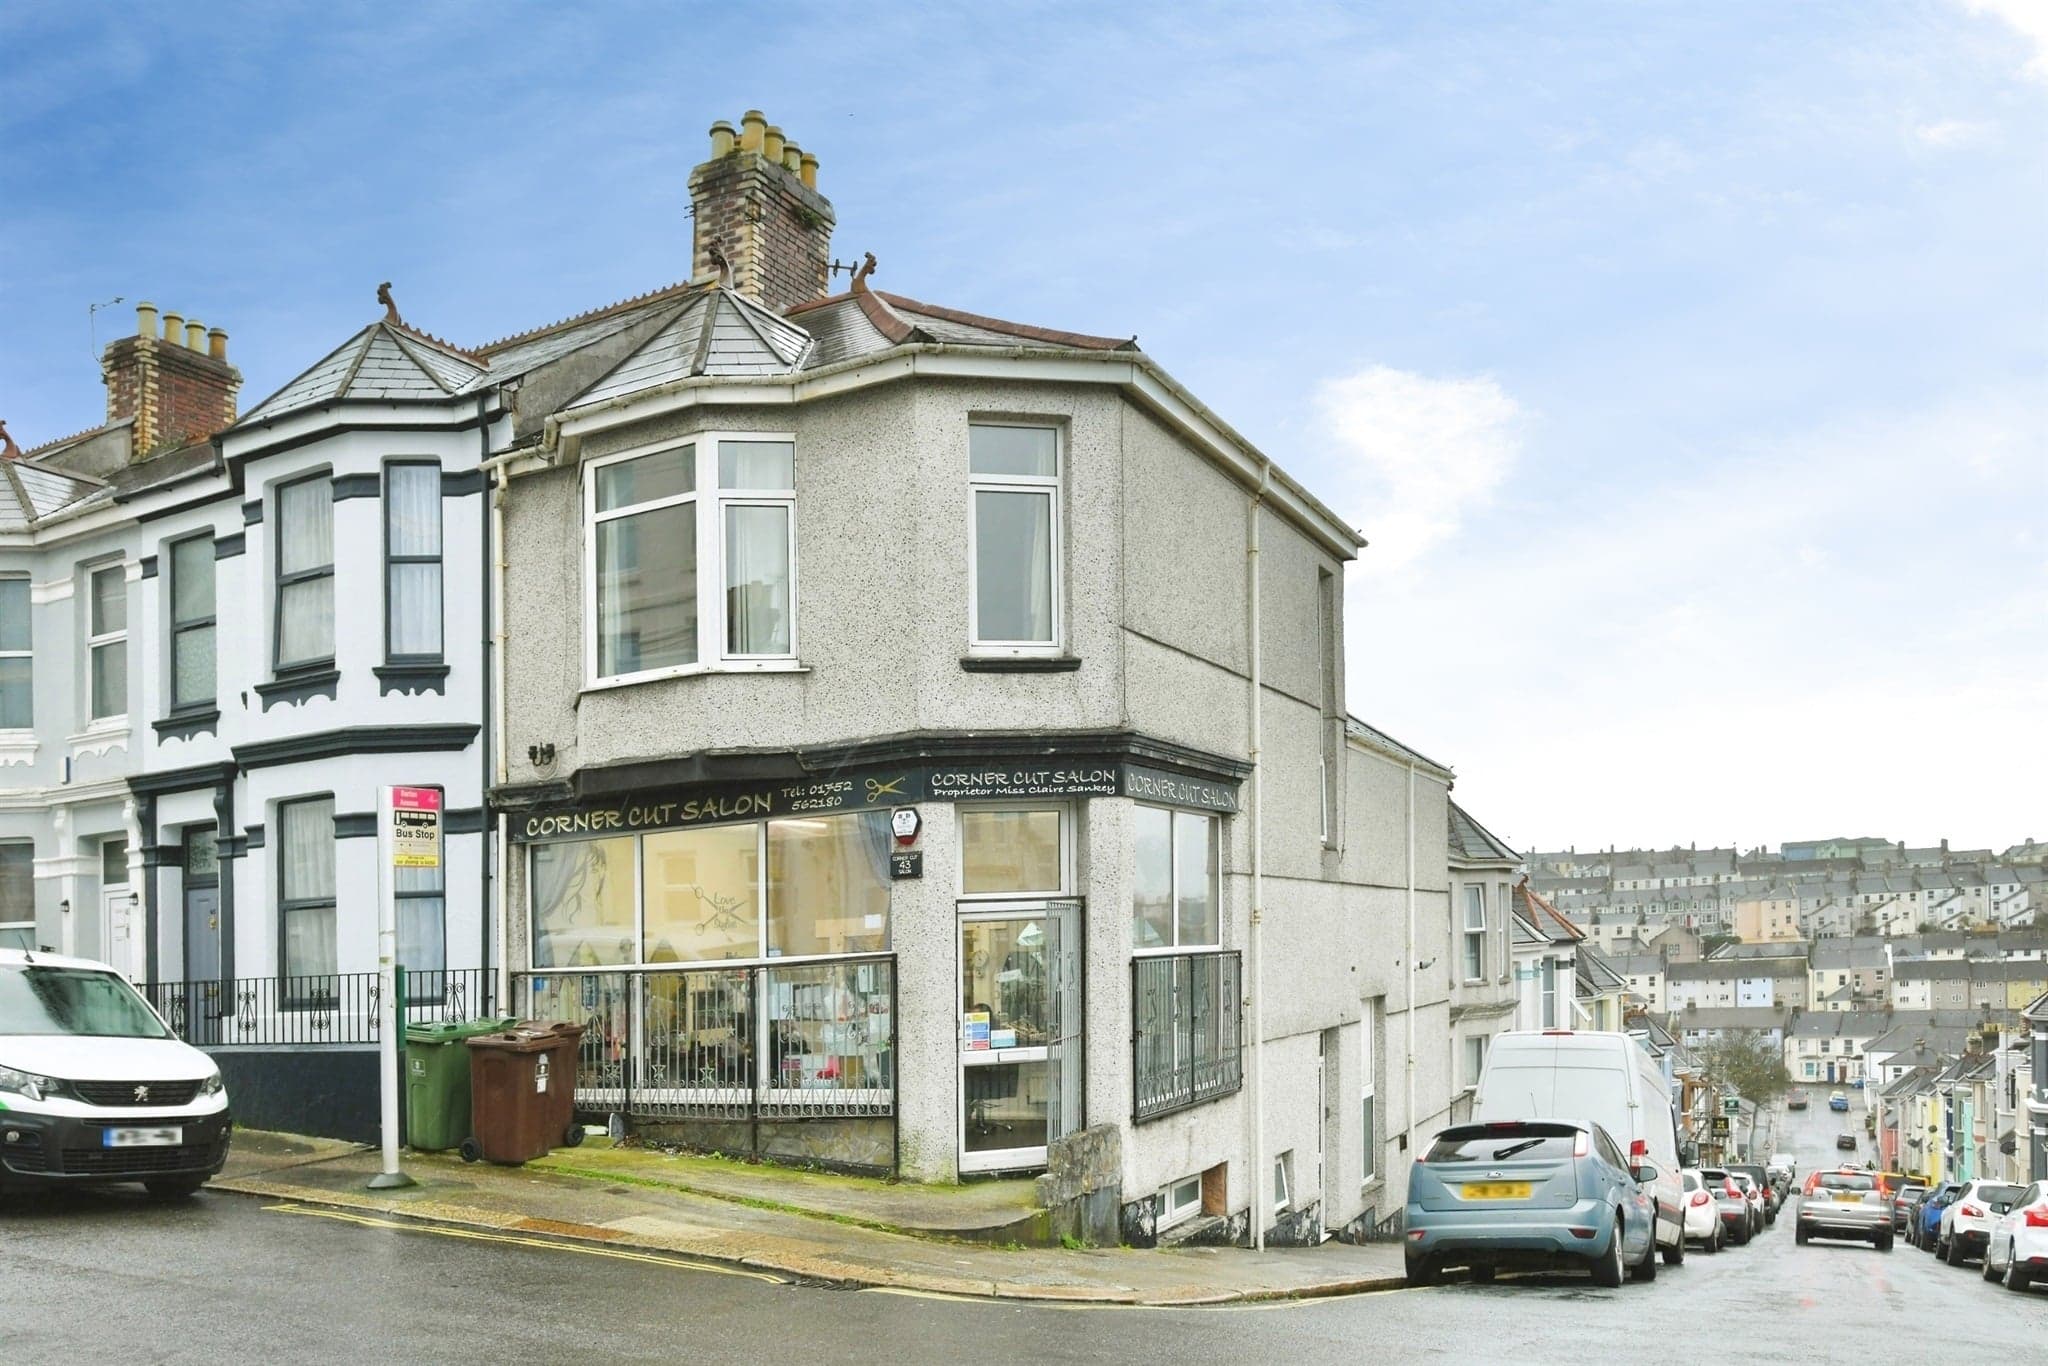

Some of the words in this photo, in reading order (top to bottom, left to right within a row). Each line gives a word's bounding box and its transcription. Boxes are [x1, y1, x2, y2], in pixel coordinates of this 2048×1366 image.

[929, 772, 1009, 786] CORNER
[1013, 772, 1050, 785] CUT
[1052, 769, 1115, 783] SALON
[781, 788, 806, 798] Tel:
[809, 781, 853, 795] 01752
[933, 787, 993, 798] Proprietor
[995, 785, 1025, 795] Miss
[1028, 784, 1064, 794] Claire
[1066, 784, 1116, 795] Sankey
[1127, 772, 1177, 799] CORNER
[1178, 783, 1201, 803] CUT
[1200, 788, 1236, 808] SALON
[791, 796, 842, 811] 562180
[526, 809, 624, 836] CORNER
[628, 803, 676, 826] CUT
[680, 792, 772, 821] SALON
[396, 828, 413, 838] Bus
[415, 829, 435, 840] Stop
[899, 860, 911, 869] 43
